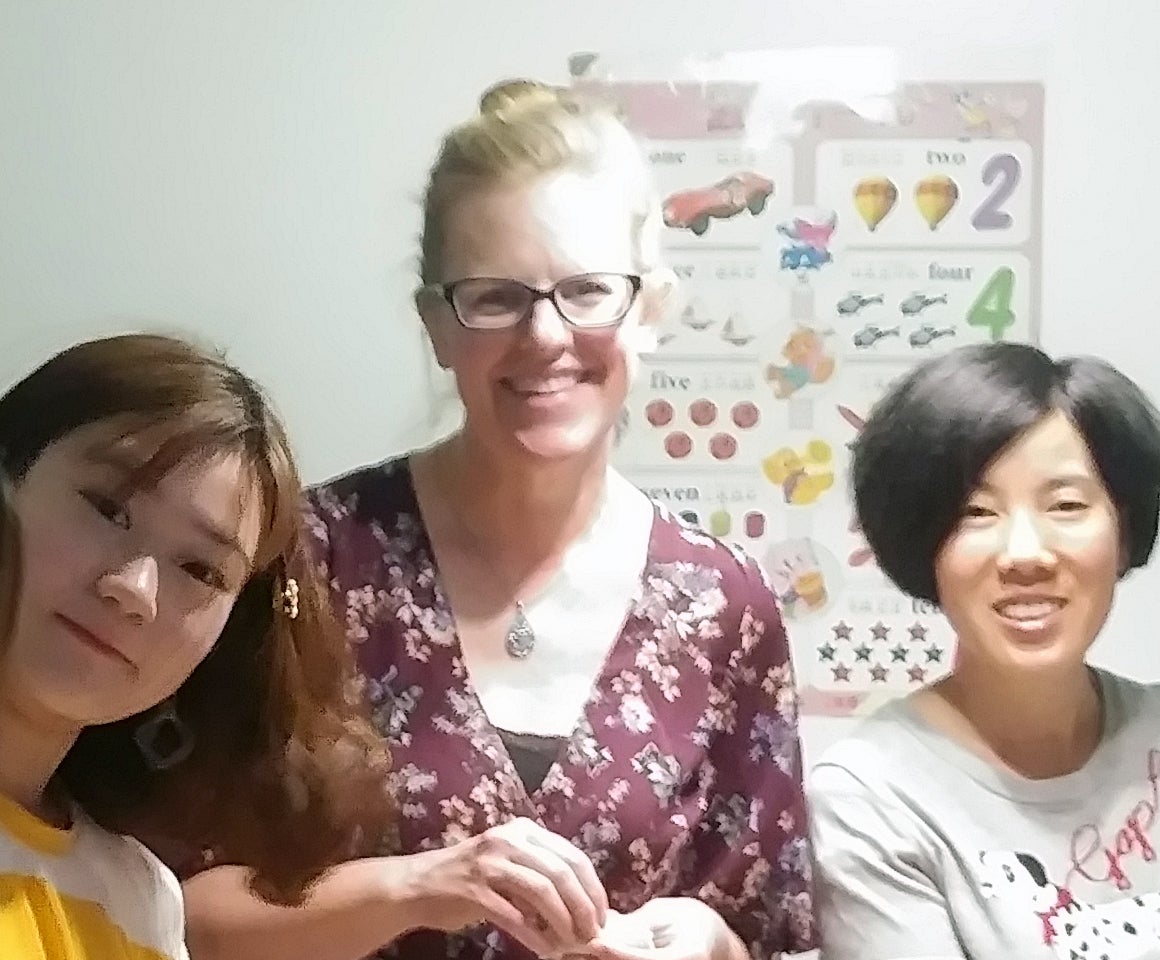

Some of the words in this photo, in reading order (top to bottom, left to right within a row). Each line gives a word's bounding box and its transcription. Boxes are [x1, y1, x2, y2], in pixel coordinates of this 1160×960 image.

[925, 150, 967, 165] two
[970, 152, 1022, 231] 2
[928, 262, 973, 281] four
[966, 266, 1017, 342] 4
[649, 369, 691, 389] five
